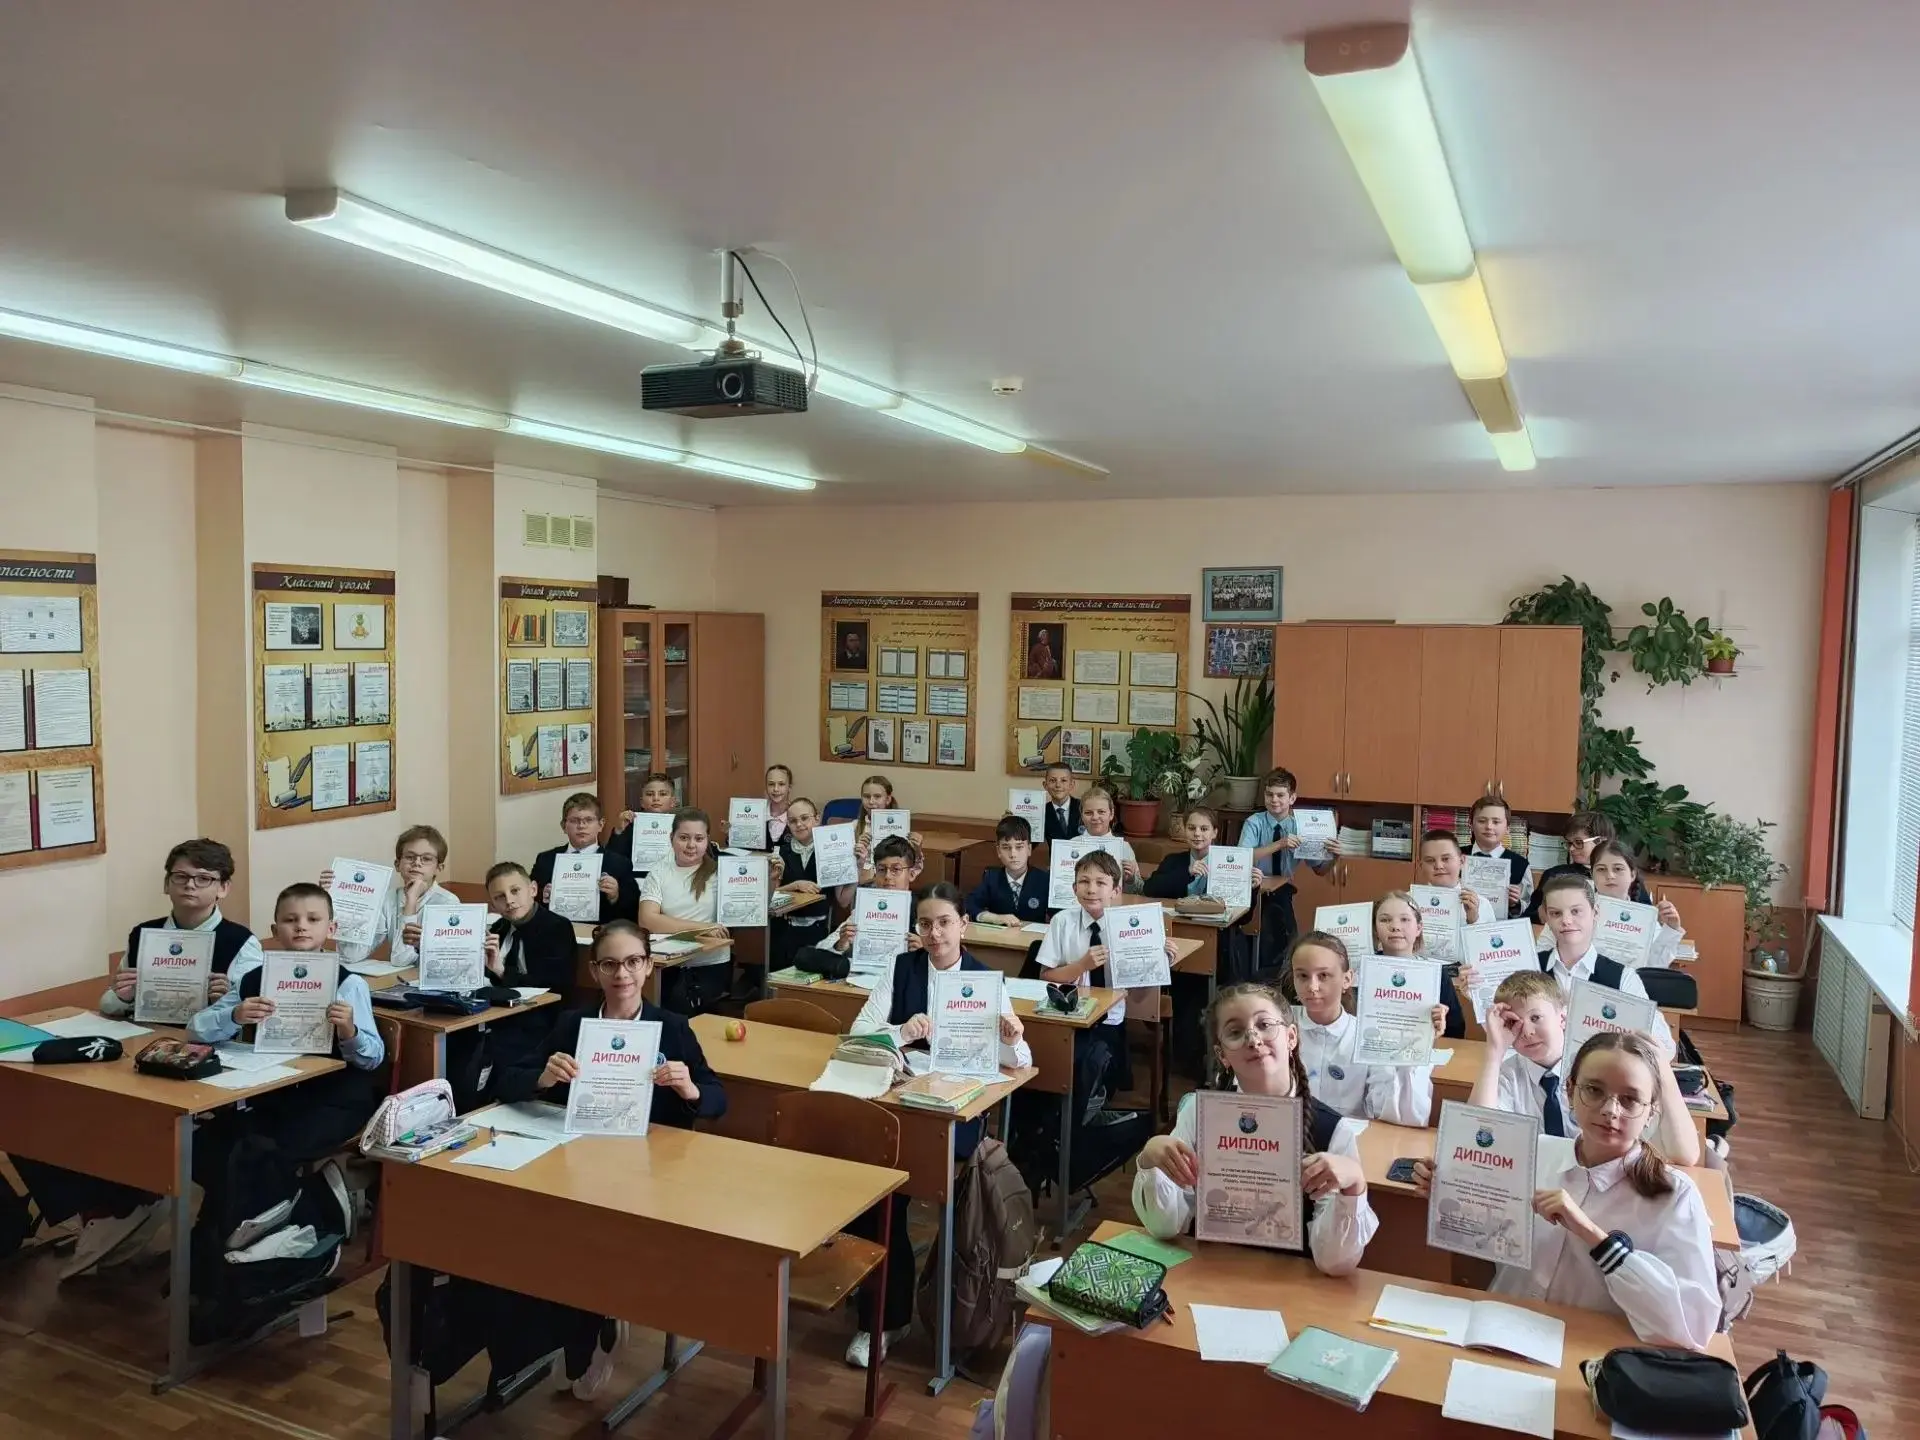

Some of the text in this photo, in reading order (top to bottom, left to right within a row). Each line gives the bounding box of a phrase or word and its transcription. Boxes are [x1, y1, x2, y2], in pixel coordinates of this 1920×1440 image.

[0, 566, 75, 578] пасности
[280, 575, 373, 593] Классный уголок
[916, 599, 967, 607] стилистика
[1033, 599, 1162, 612] Языковедческая стилистика
[1217, 863, 1243, 871] ДИПЛОМ
[728, 876, 758, 884] ДИПЛОМ
[338, 881, 375, 894] ДИПЛОМ
[866, 911, 898, 920] ДИПЛОМ
[434, 927, 473, 937] ДИПЛОМ
[1327, 925, 1360, 934] ДИПЛОМ
[1605, 920, 1641, 934] ДИПЛОМ
[1118, 928, 1153, 939] ДИПЛОМ
[1479, 948, 1521, 962] ДИПЛОМ
[152, 957, 196, 967] ДИПЛОМ
[277, 980, 322, 990] ДИПЛОМ
[1374, 988, 1423, 1001] ДИПЛОМ
[946, 1000, 987, 1010] ДИПЛОМ
[592, 1052, 640, 1064] ДИПЛОМ
[1218, 1135, 1280, 1152] ДИПЛОМ
[1453, 1146, 1513, 1169] ДИПЛОМ
